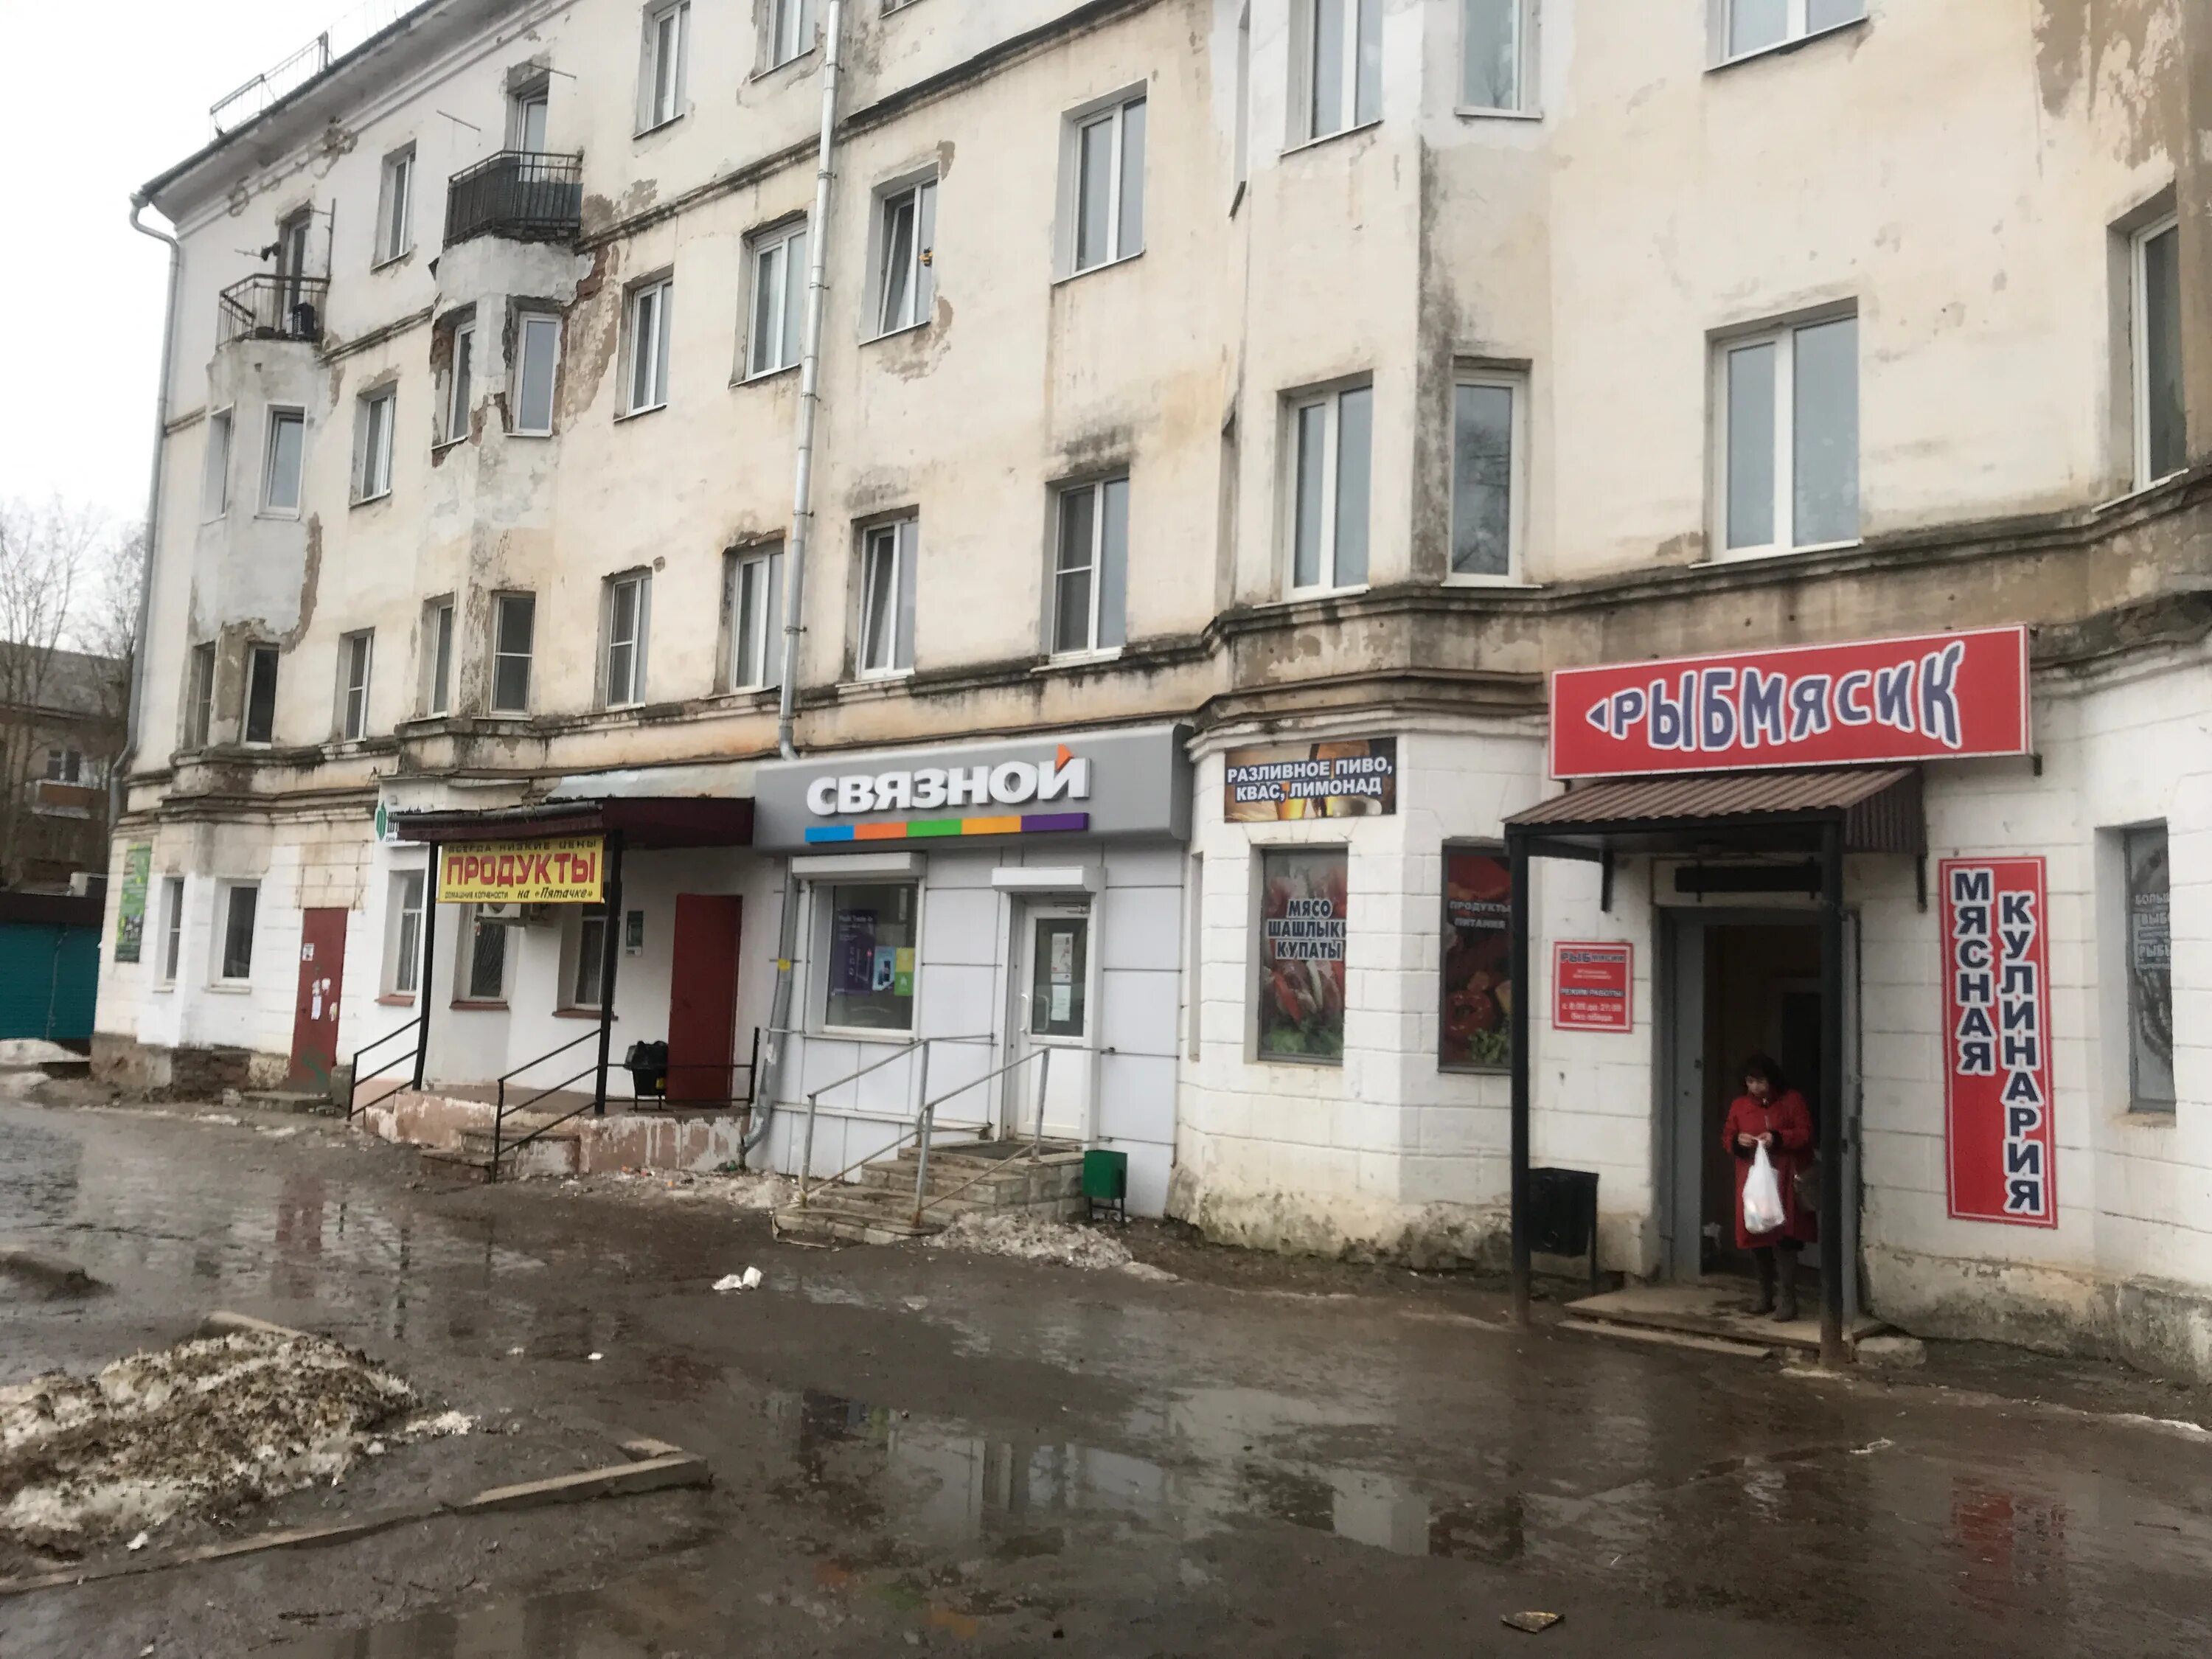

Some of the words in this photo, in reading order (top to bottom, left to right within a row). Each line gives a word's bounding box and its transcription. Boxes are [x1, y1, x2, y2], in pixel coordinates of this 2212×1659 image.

[1610, 641, 1965, 751] РЫБМЯСИК
[807, 743, 1091, 816] СВЯЗНОЙ
[1227, 761, 1330, 783] РАЗЛИВНОЕ
[1335, 757, 1392, 774] ПИВО,
[1237, 785, 1285, 801] КВАС,
[1290, 776, 1382, 797] ЛИМОНАД
[499, 842, 550, 852] НИЗКИЕ
[559, 840, 596, 849] ЦЕНЫ
[447, 852, 596, 887] ПРОДУКТЫ
[518, 890, 529, 899] на
[1287, 900, 1332, 917] МЯСО
[1276, 942, 1342, 959] КУПАТЫ
[1952, 870, 1994, 1074] МЯСНАЯ
[2000, 893, 2043, 1214] КУЛИНАРИЯ
